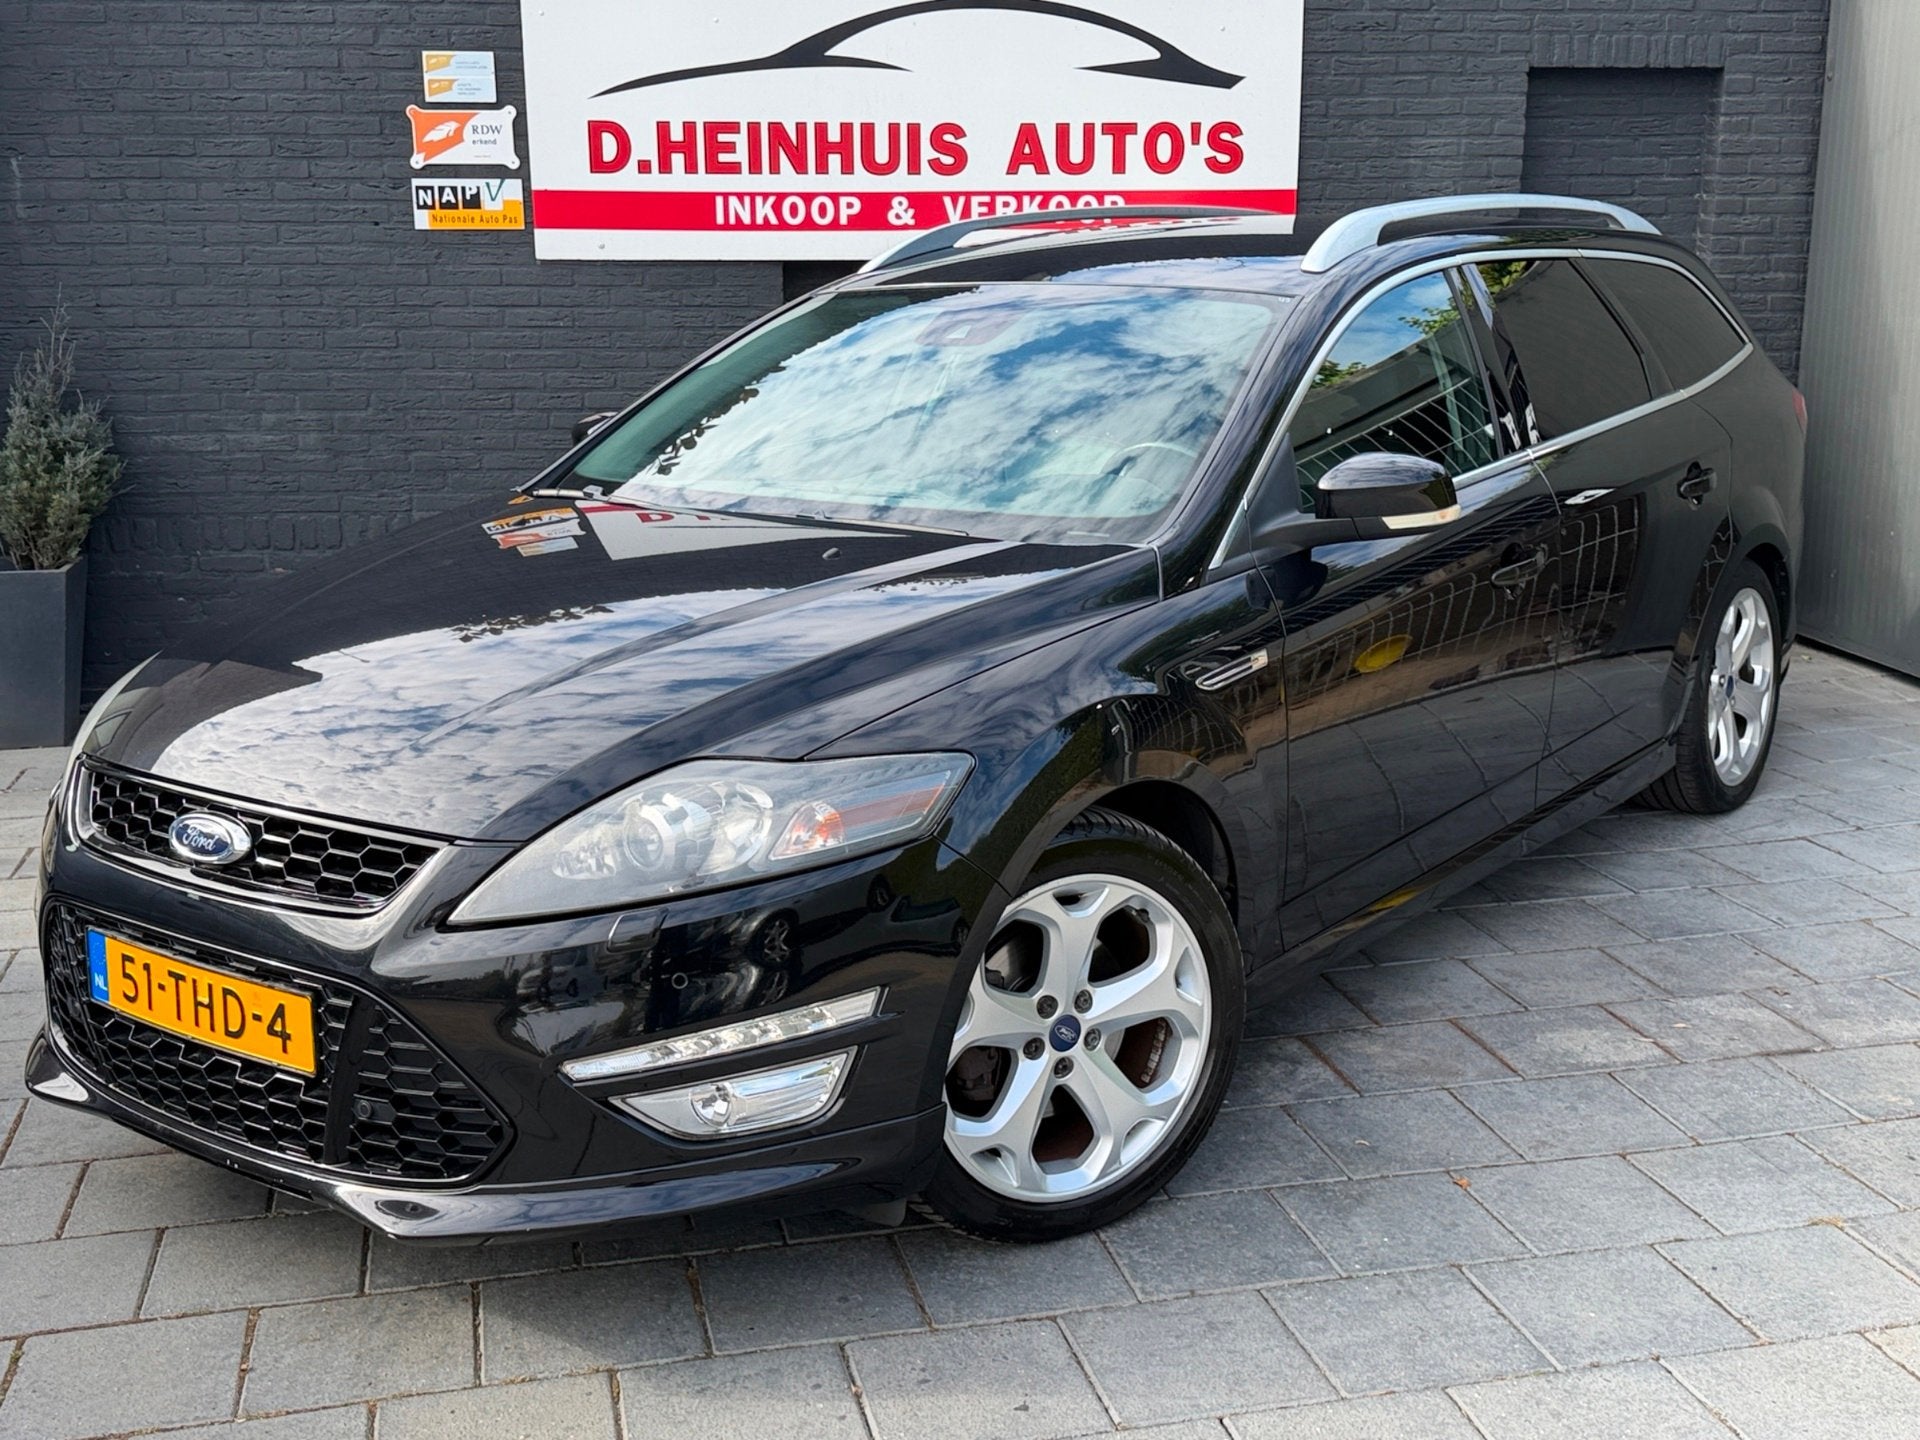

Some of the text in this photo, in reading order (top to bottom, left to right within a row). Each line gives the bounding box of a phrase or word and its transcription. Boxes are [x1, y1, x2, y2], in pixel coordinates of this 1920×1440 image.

[471, 124, 503, 135] RDW
[472, 138, 498, 146] erkend
[587, 119, 1245, 177] D.HEINHUIS AUTO'S
[431, 213, 518, 225] Nationale Auto Pas
[714, 195, 862, 226] INKOOP
[886, 196, 917, 227] &
[182, 824, 220, 852] Ford
[94, 971, 108, 991] NL
[121, 952, 292, 1055] 51-THD-4
